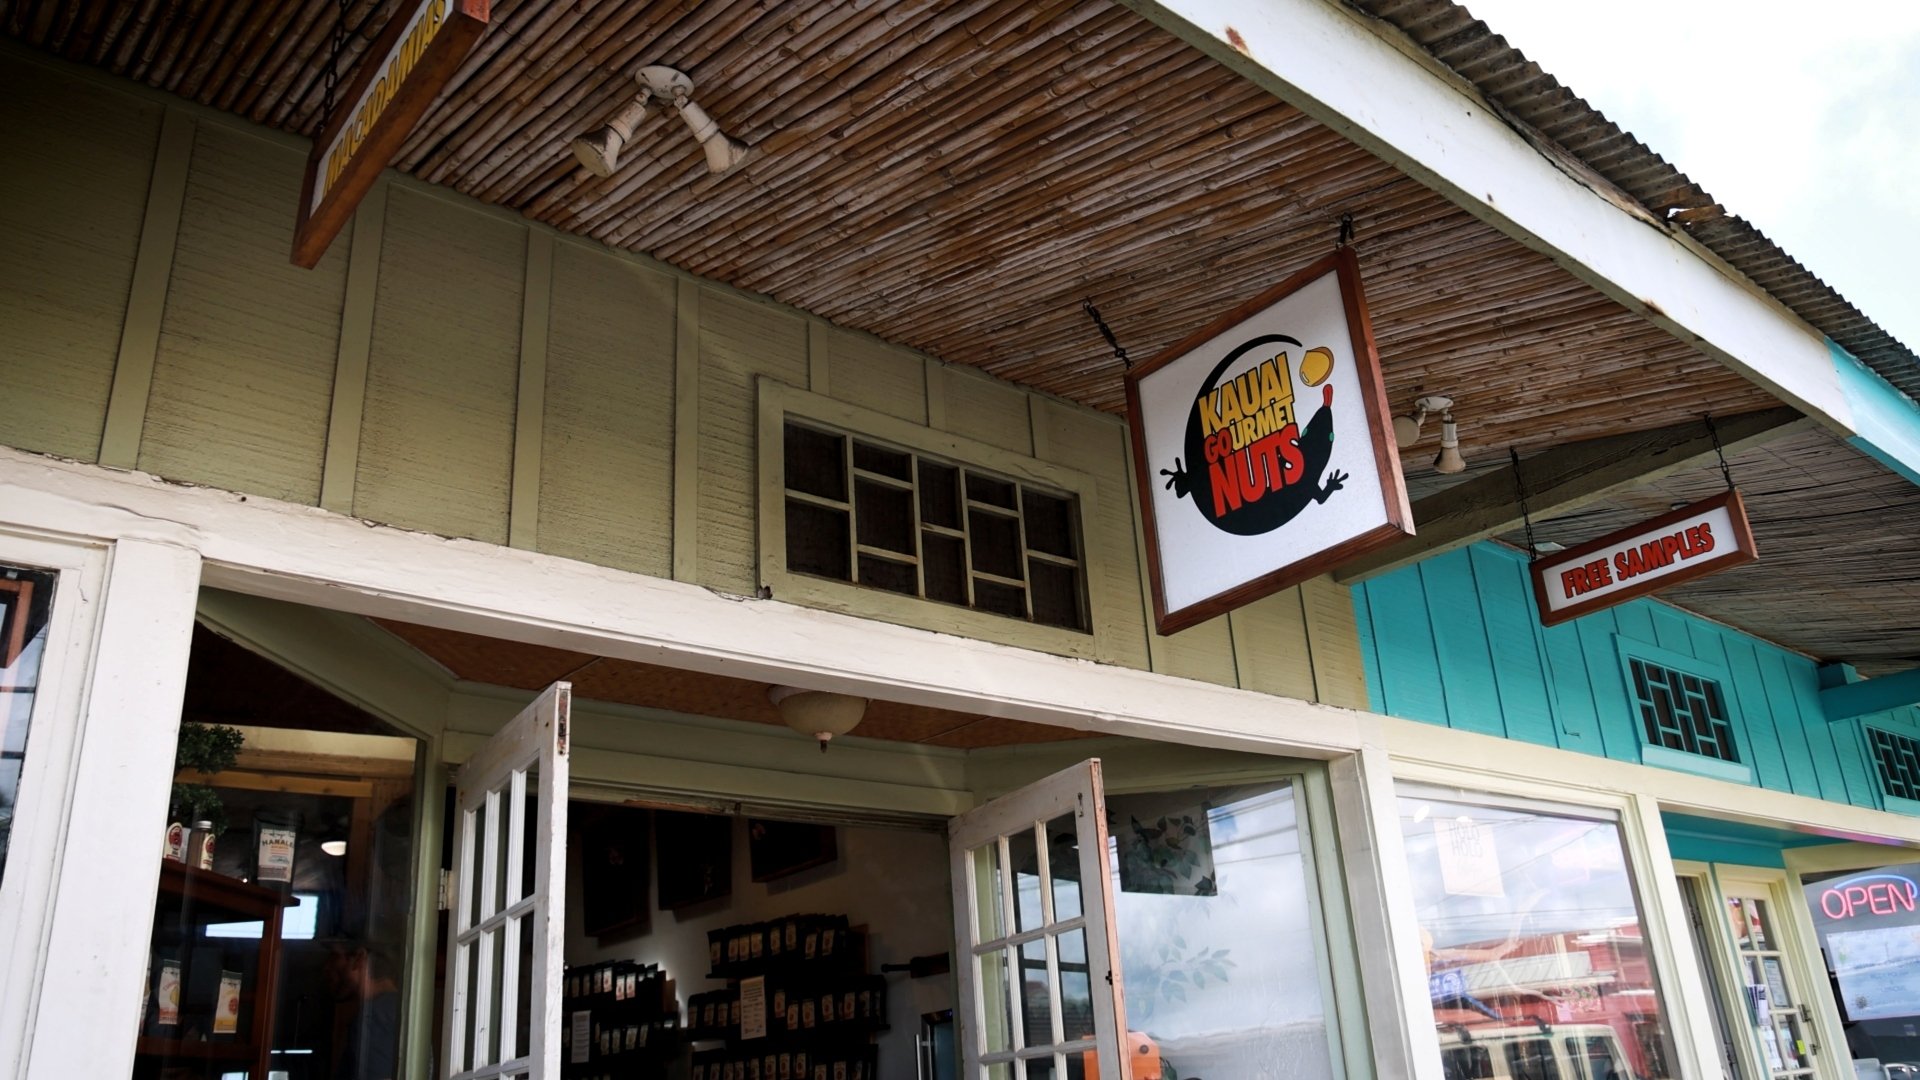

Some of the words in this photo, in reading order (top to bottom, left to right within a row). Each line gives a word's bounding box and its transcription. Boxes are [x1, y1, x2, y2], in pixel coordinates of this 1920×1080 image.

[1198, 351, 1294, 439] KAUAI
[1204, 397, 1297, 464] GOURMET
[1208, 422, 1305, 518] NUTS
[1560, 557, 1613, 599] FREE
[1613, 522, 1715, 581] SAMPLES
[1821, 883, 1915, 919] OPEN
